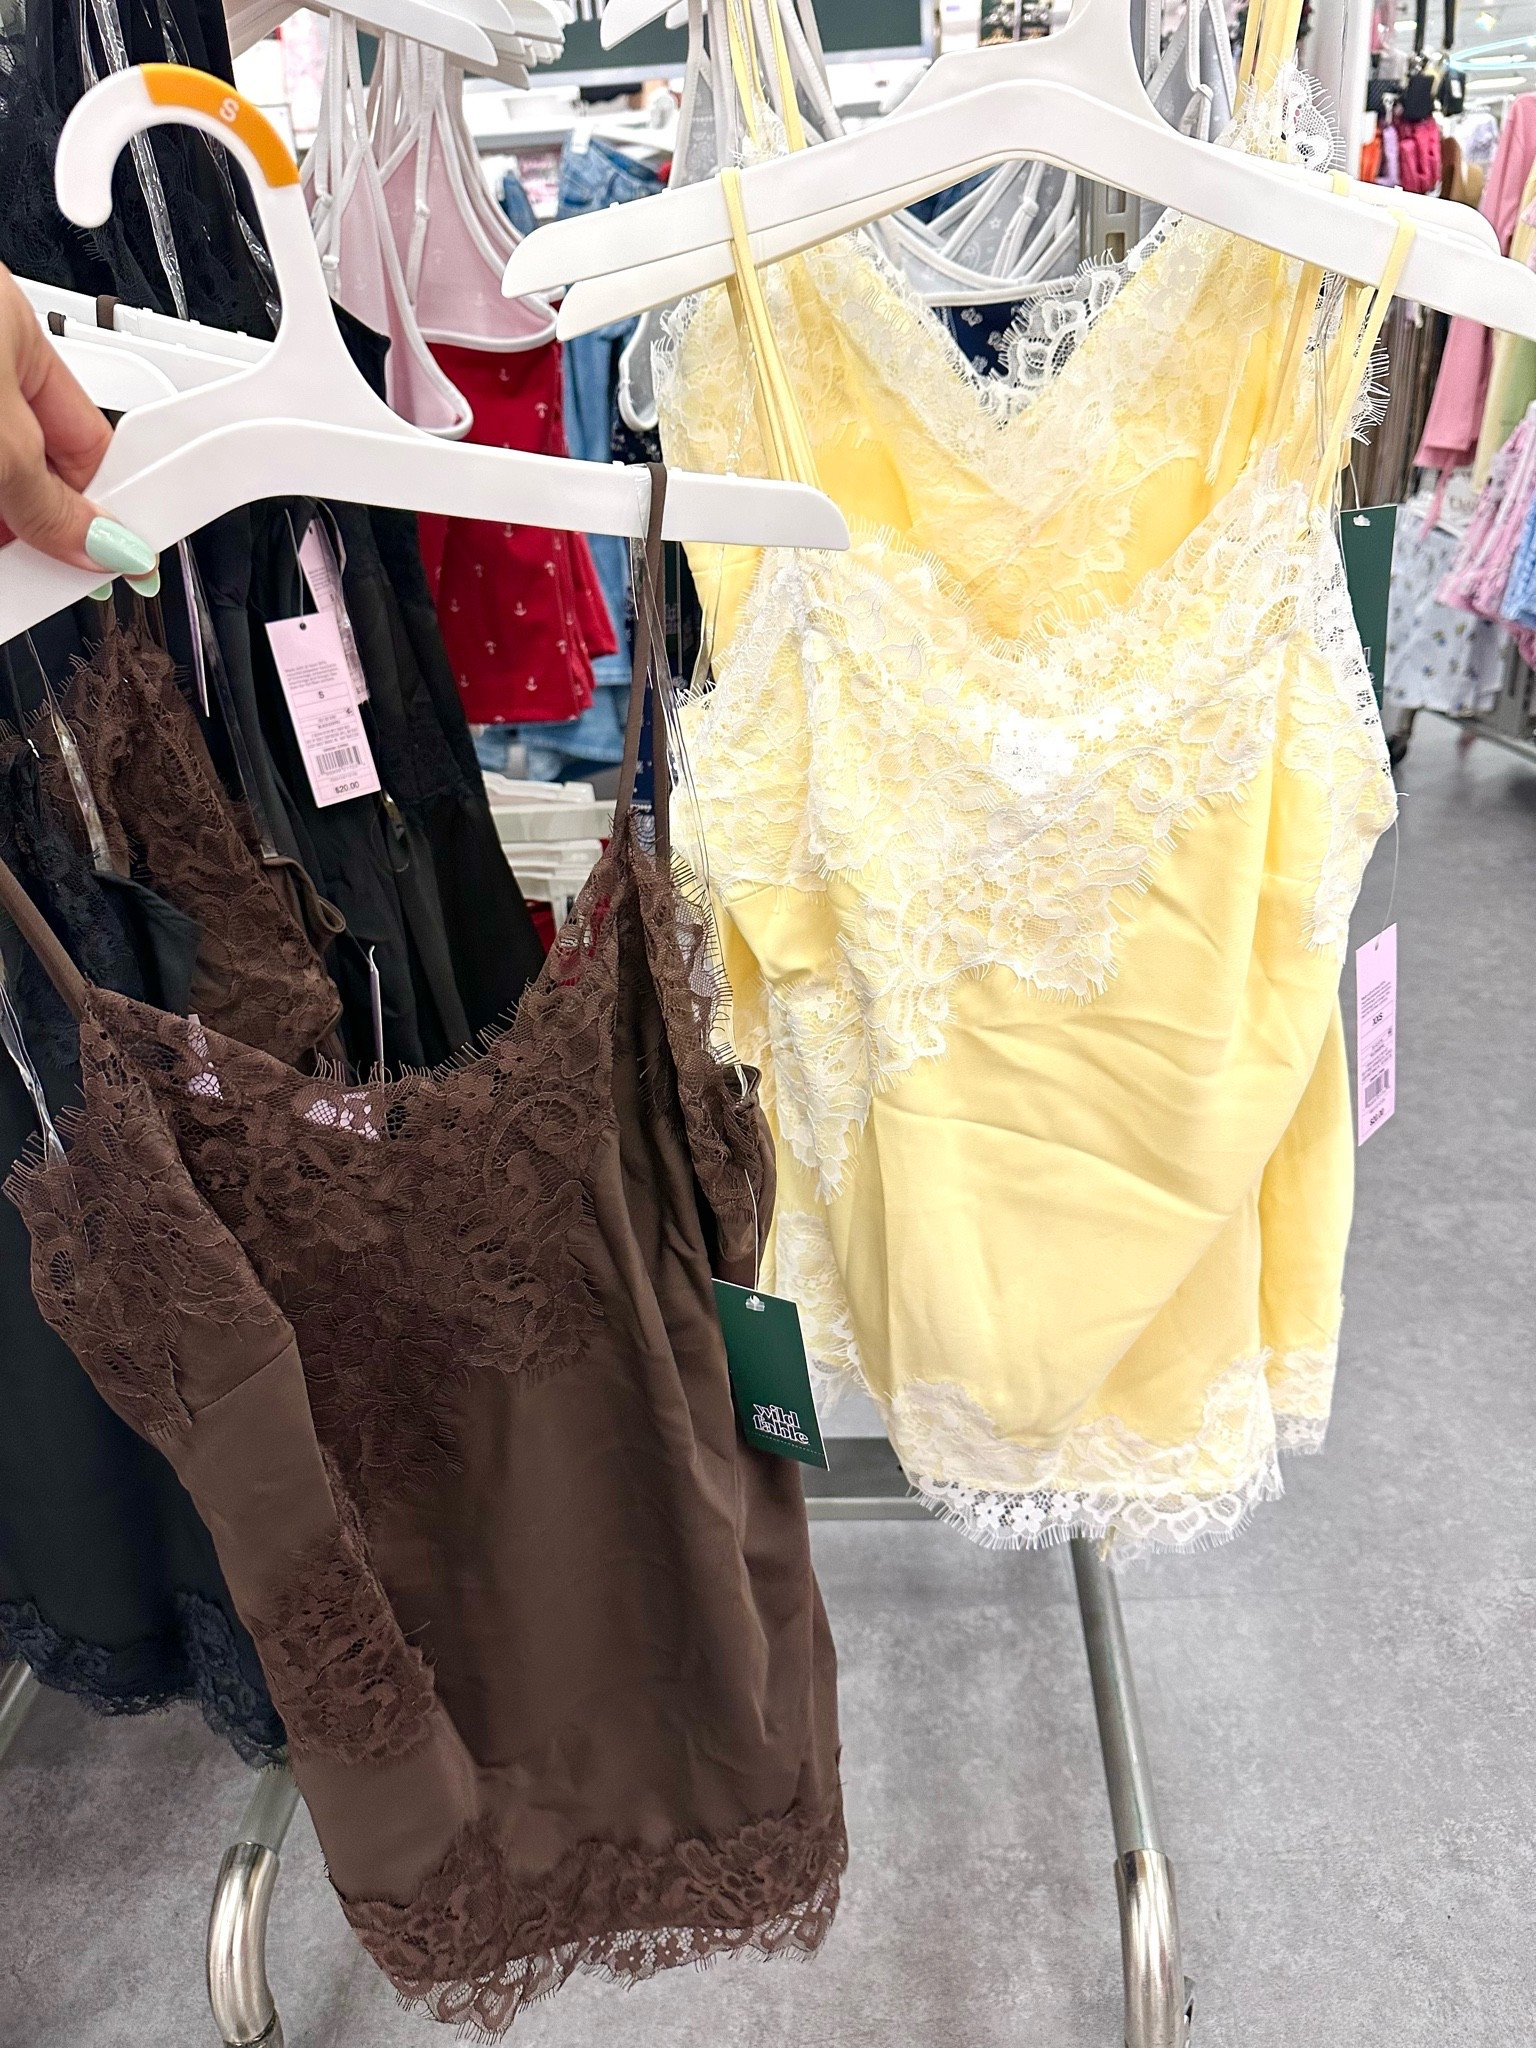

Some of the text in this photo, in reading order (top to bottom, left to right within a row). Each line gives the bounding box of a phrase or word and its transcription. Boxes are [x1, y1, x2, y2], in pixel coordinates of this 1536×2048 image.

[219, 97, 240, 123] S
[318, 691, 325, 699] S
[335, 781, 360, 794] $20.00
[753, 1404, 801, 1429] wild
[753, 1414, 809, 1445] fable
